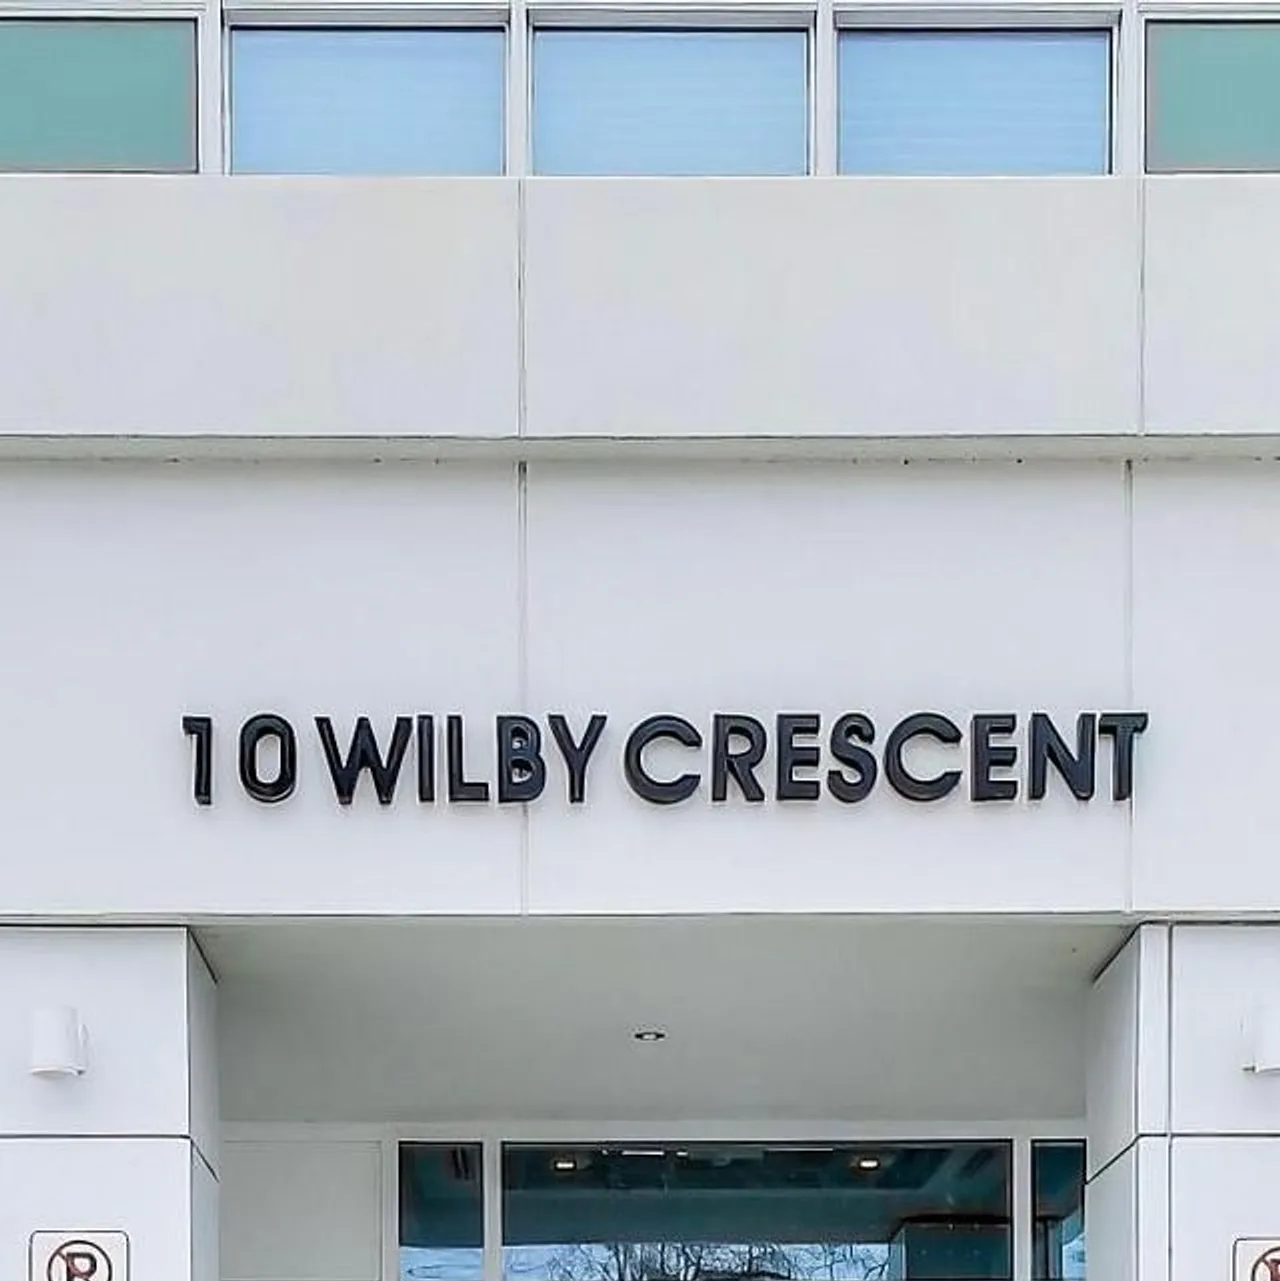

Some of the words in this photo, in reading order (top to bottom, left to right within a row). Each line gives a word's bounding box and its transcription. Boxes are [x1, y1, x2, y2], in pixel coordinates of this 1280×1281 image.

[182, 714, 296, 805] 10
[314, 714, 607, 805] WILBY
[624, 712, 1149, 805] CRESCENT
